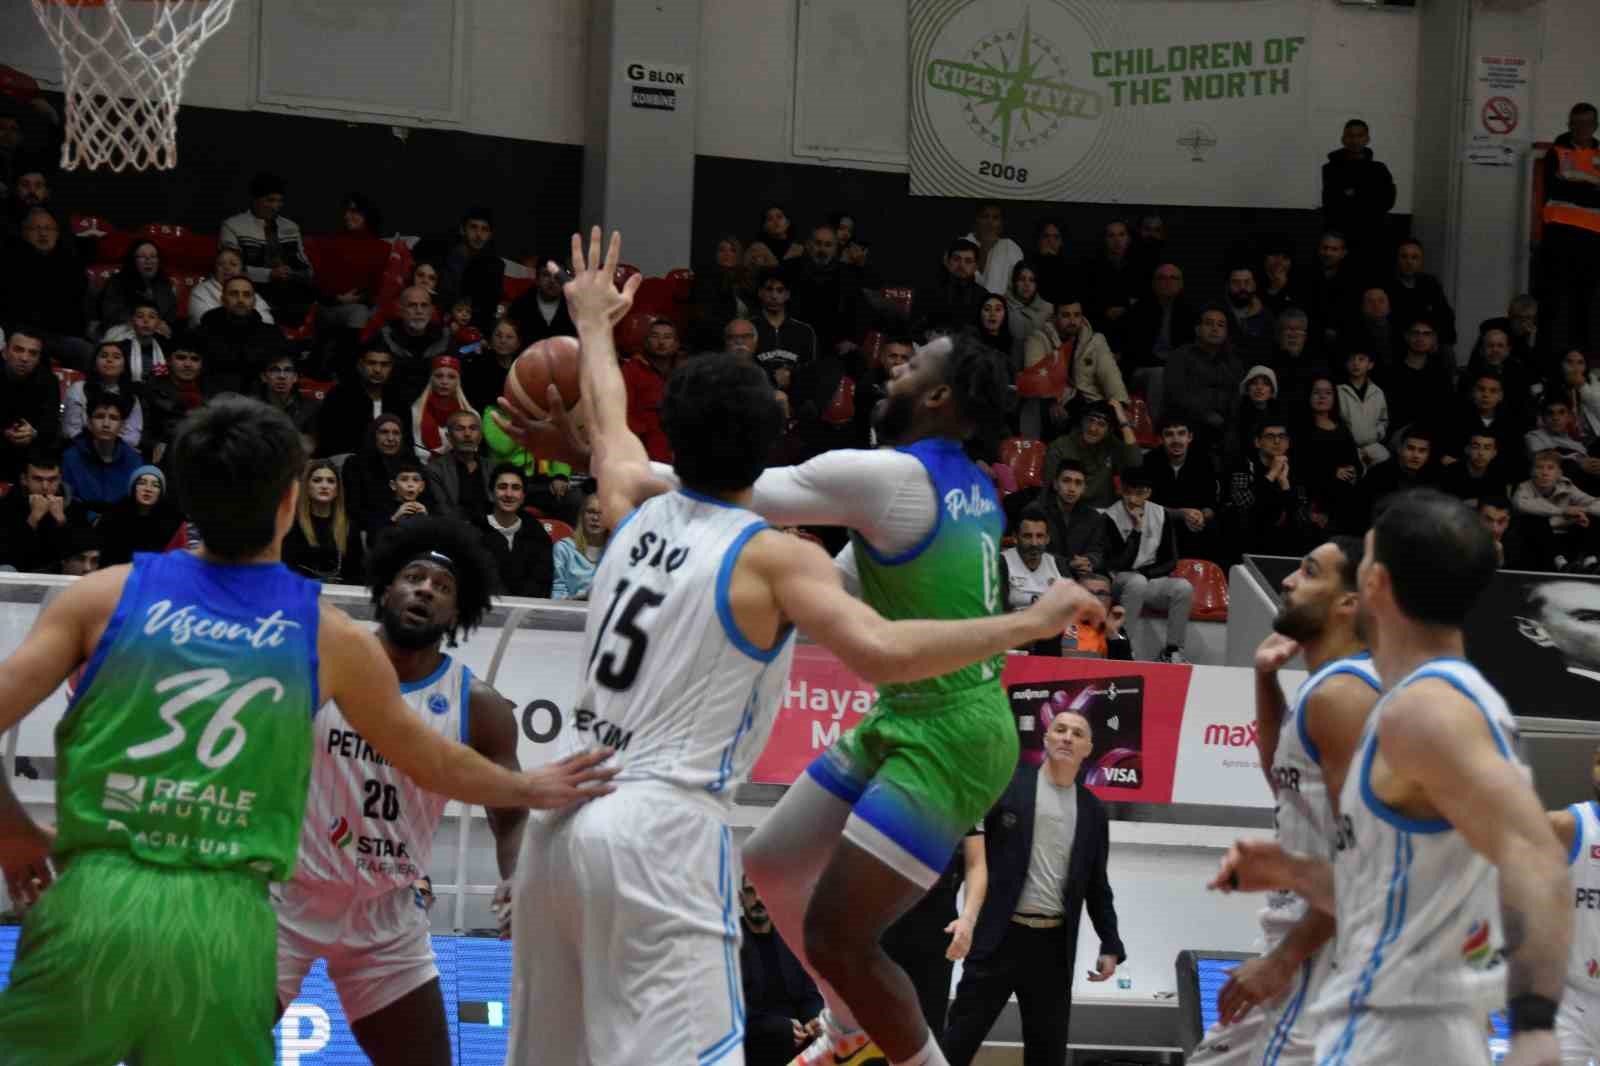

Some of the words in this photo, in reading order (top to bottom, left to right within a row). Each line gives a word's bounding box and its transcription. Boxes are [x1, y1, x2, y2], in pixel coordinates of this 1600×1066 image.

[627, 64, 645, 80] G
[648, 70, 684, 85] BLOK
[1091, 41, 1253, 77] CHILDREN
[1264, 36, 1305, 65] OF
[1108, 77, 1171, 107] THE
[1182, 68, 1289, 101] NORTH
[978, 161, 1029, 183] 2008
[143, 599, 303, 648] Visconti
[584, 577, 667, 693] 15
[127, 667, 284, 769] 36
[783, 680, 880, 720] Haya
[327, 728, 393, 768] PETK
[1103, 766, 1139, 783] VISA
[148, 801, 249, 827] MUTUA
[152, 778, 257, 812] REALE
[363, 779, 399, 822] 20
[357, 836, 410, 858] STAR
